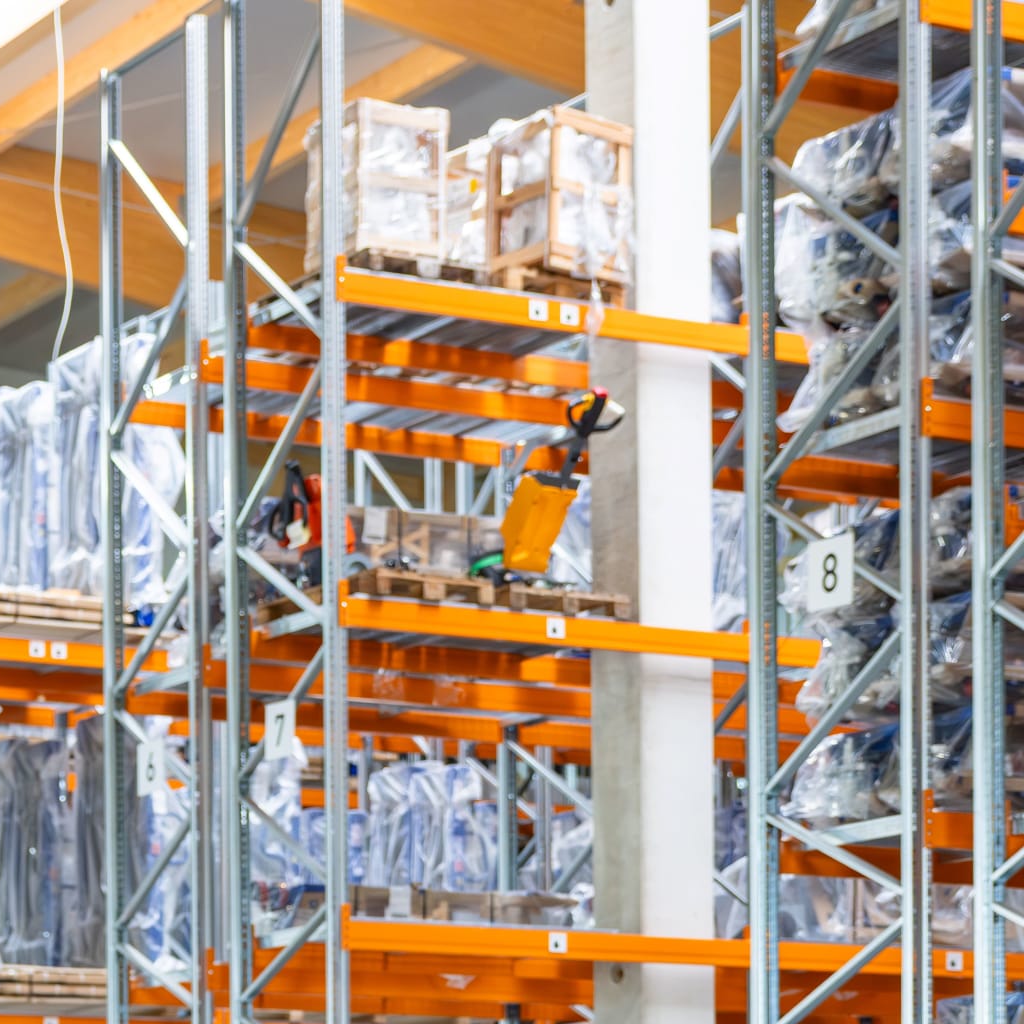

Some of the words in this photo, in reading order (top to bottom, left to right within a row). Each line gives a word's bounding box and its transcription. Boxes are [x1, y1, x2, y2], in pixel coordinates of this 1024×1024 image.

[822, 553, 837, 592] 8
[275, 714, 285, 747] 7
[146, 751, 156, 782] 6
